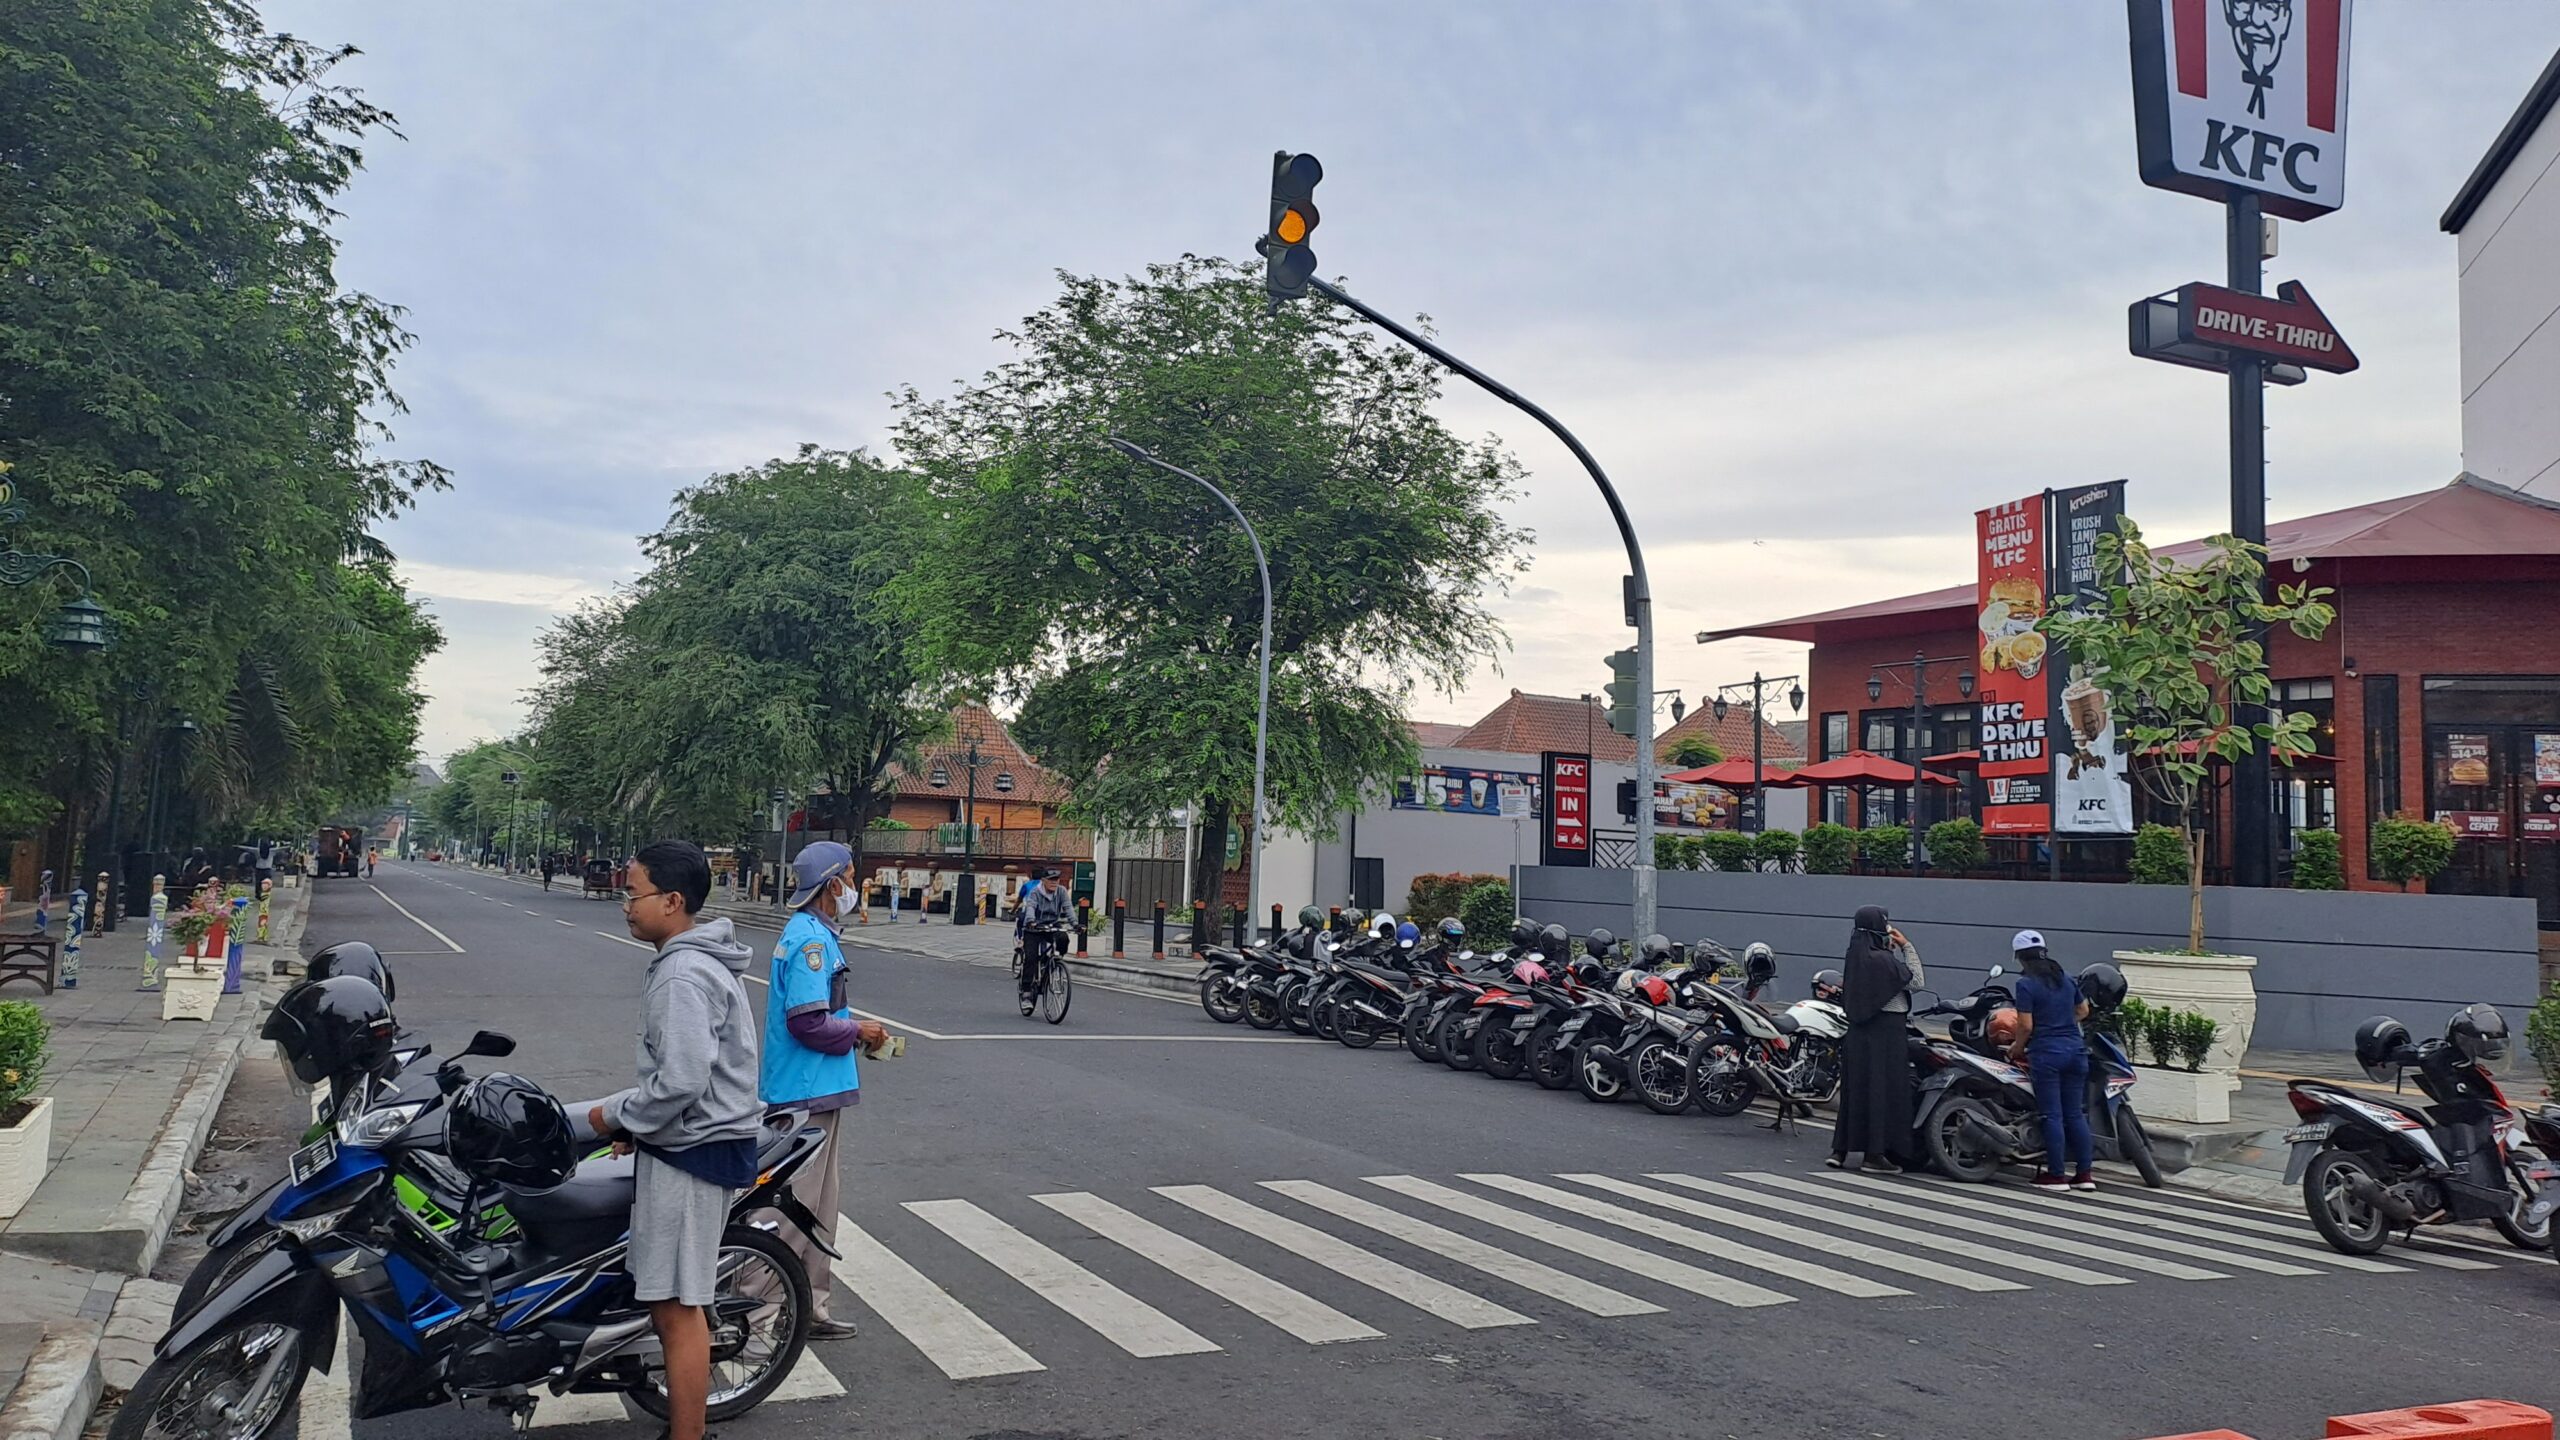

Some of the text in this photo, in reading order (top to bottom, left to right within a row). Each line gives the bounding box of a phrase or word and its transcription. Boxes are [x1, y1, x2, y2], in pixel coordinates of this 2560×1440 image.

[2200, 118, 2320, 194] KFC
[2197, 306, 2334, 353] DRIVE-THRU
[1989, 513, 2028, 536] GRATIS
[2071, 515, 2101, 531] KRUSH
[1985, 529, 2034, 553] MENU
[2072, 528, 2097, 544] KAMU
[2072, 542, 2095, 557] BUAT
[1993, 548, 2027, 569] KFC
[2072, 568, 2093, 582] HARI
[1982, 691, 1995, 702] DI
[1982, 702, 2024, 722] KFC
[1982, 719, 2046, 742] DRIVE
[1983, 740, 2041, 761] THRU
[1557, 763, 1584, 777] KFC
[1447, 778, 1463, 789] RIBU
[1556, 785, 1586, 794] DRIVE-THRU
[1561, 797, 1579, 812] IN
[1656, 805, 1681, 814] COMBO
[2078, 799, 2106, 811] KFC
[379, 1077, 400, 1094] HONDA
